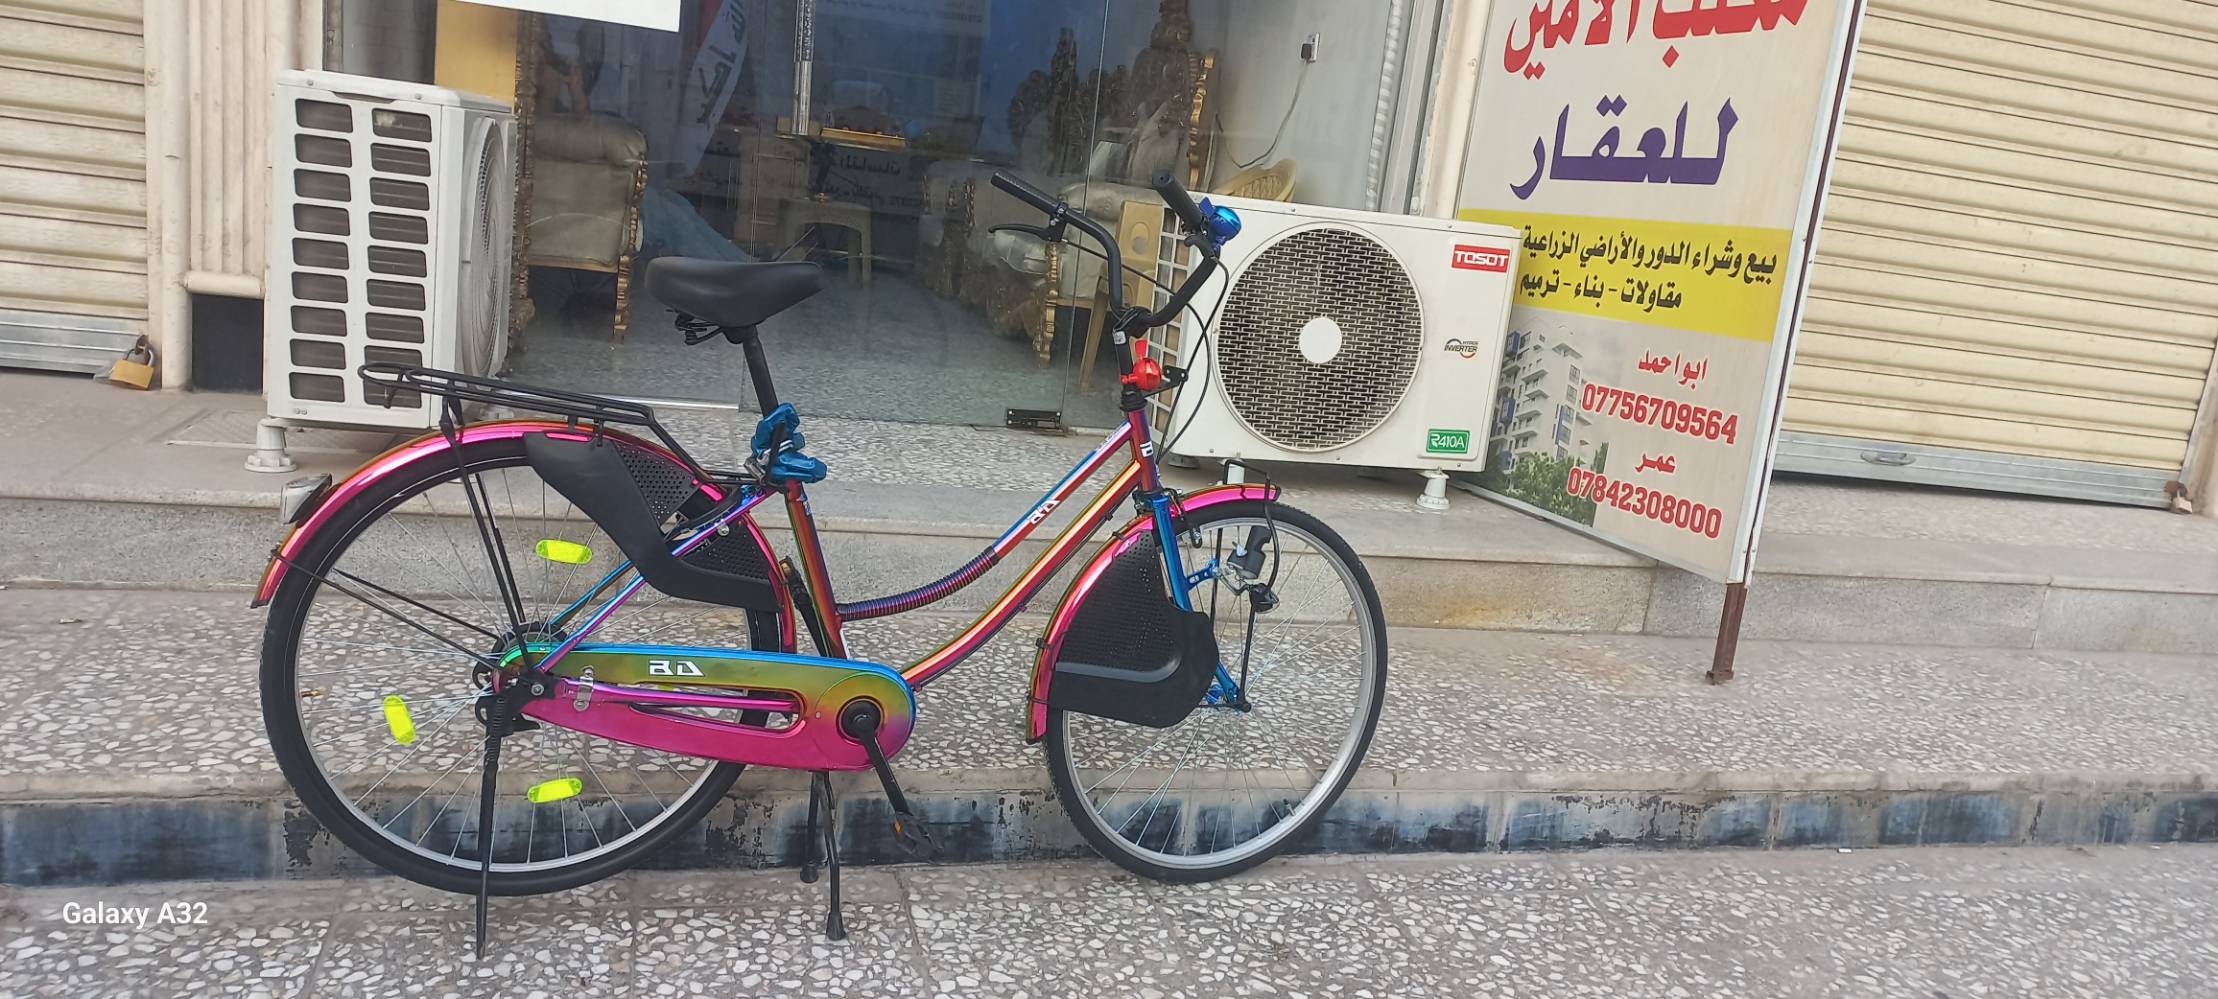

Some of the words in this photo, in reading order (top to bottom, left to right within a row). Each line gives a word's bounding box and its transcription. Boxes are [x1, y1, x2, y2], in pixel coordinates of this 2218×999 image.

[1510, 95, 1739, 200] للعقار
[1455, 251, 1508, 267] TOSOT
[1523, 225, 1579, 260] الزراعية
[1645, 241, 1691, 269] الدور
[1692, 240, 1742, 277] وشراء
[1519, 268, 1560, 297] ترميم
[1743, 251, 1777, 284] بيع
[1574, 275, 1604, 308] بناء
[1621, 278, 1682, 312] مقاولات
[1638, 349, 1681, 379] احمد
[1678, 356, 1707, 390] ابو
[1581, 383, 1739, 445] 07756709564
[1635, 451, 1676, 474] عمر
[1567, 467, 1723, 540] 07842308000
